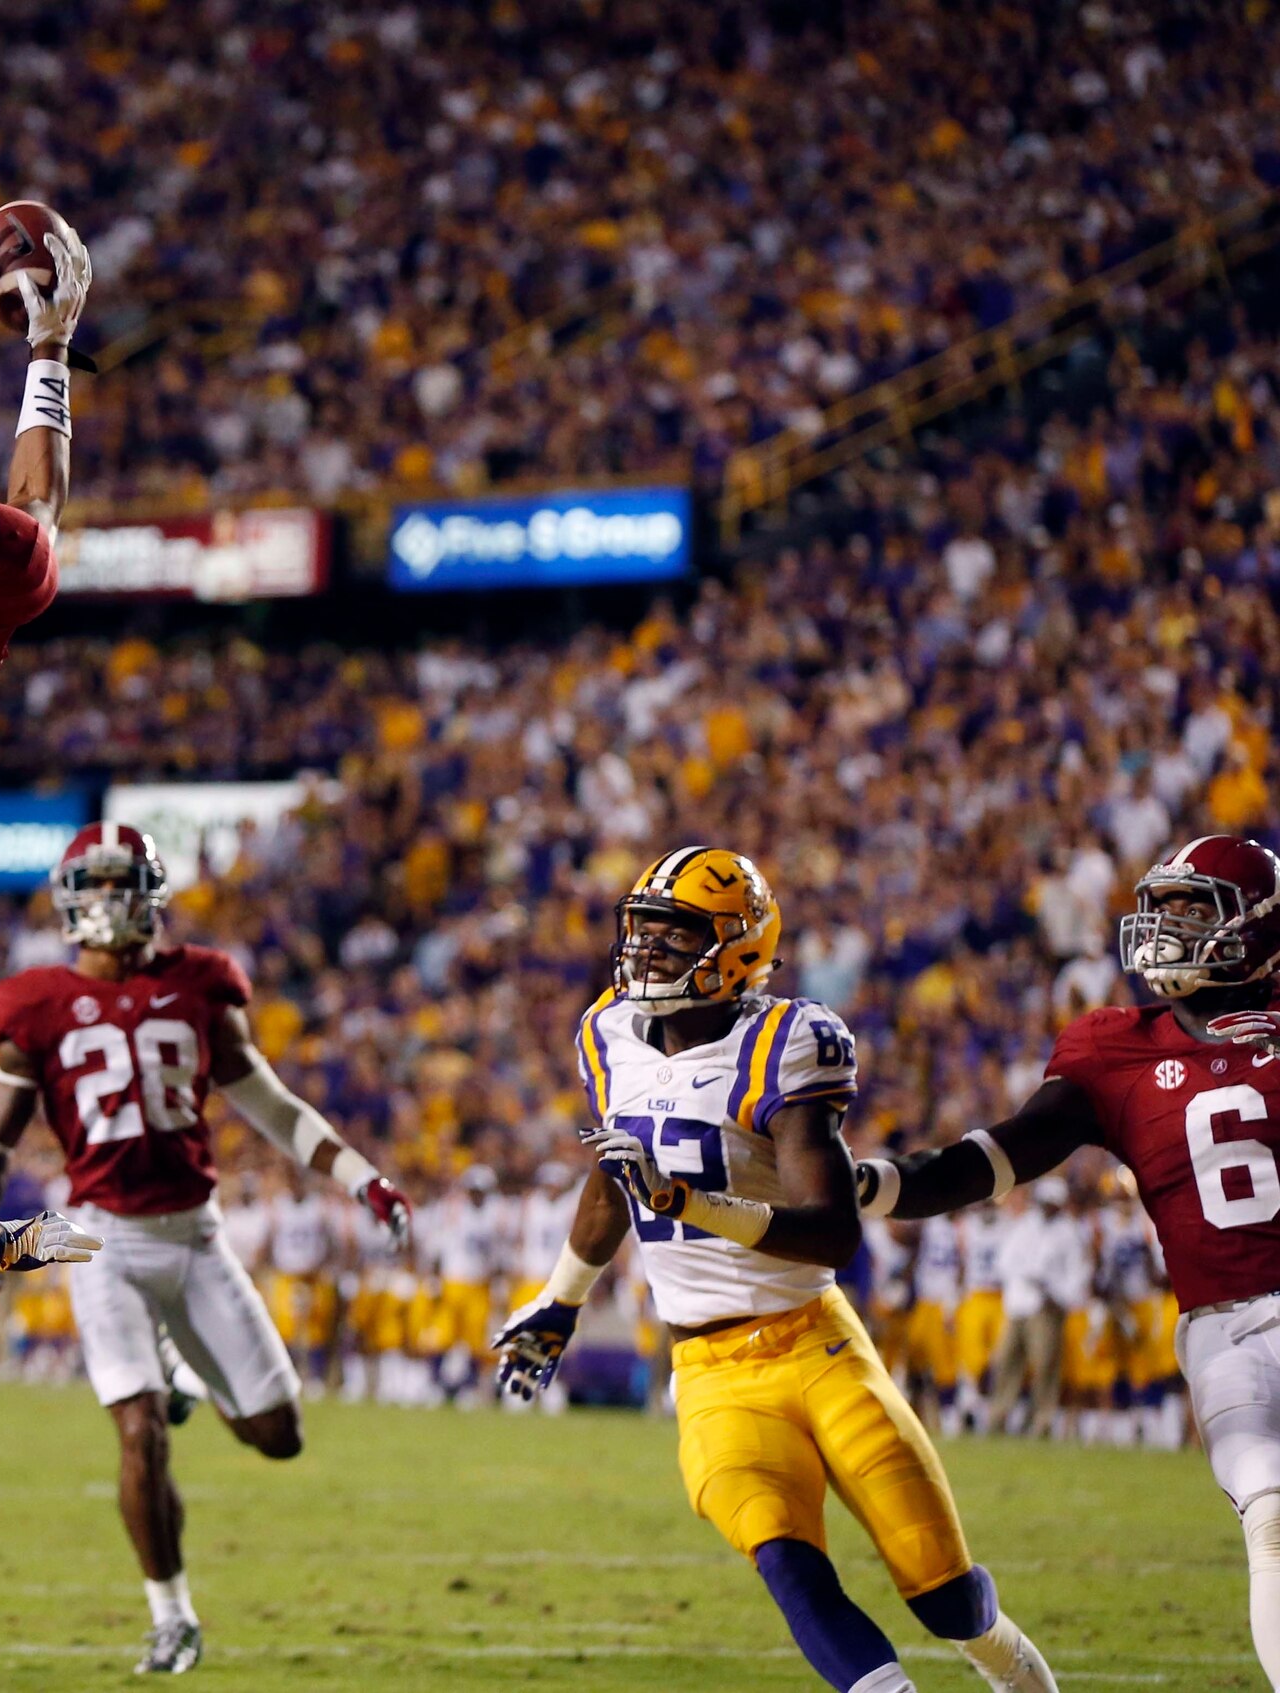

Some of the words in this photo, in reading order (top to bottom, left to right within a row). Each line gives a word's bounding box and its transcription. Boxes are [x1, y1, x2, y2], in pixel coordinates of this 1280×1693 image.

[59, 1019, 200, 1145] 28
[647, 1098, 676, 1112] LSU
[1154, 1060, 1186, 1090] SEC
[1185, 1084, 1280, 1230] 6
